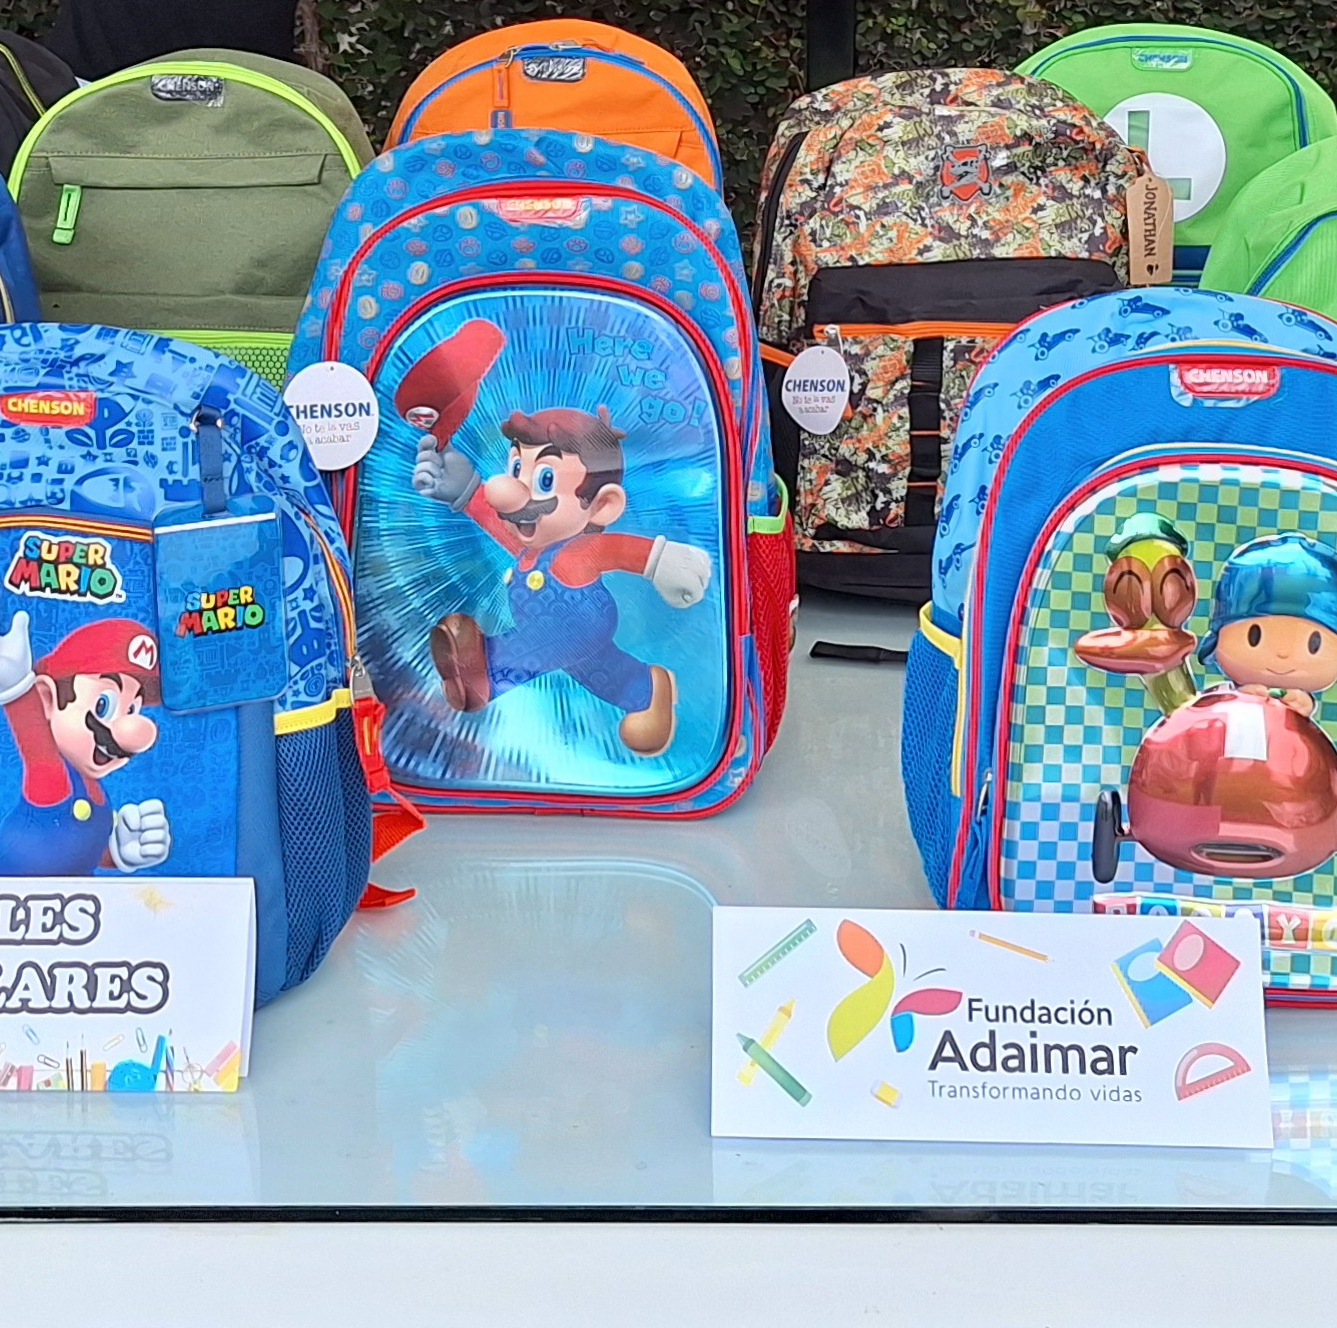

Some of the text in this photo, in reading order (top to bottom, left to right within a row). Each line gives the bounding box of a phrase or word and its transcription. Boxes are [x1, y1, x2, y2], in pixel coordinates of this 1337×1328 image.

[1143, 183, 1159, 258] JONATHAN
[565, 326, 654, 361] Here
[784, 378, 846, 393] CHENSON
[1187, 367, 1269, 384] CHENSON
[7, 397, 86, 416] CHENSON
[287, 401, 372, 420] HENSON
[637, 395, 708, 428] go!
[314, 423, 325, 433] te
[327, 421, 337, 432] la
[339, 421, 361, 432] vas
[315, 434, 352, 445] acabar
[24, 535, 107, 568] SUPER
[8, 556, 118, 600] MARIO
[185, 584, 255, 612] SUPER
[174, 603, 265, 639] MARIO
[966, 997, 1113, 1026] Fundación
[926, 1028, 1139, 1078] Adaimar
[927, 1079, 1144, 1104] Transformando vidas
